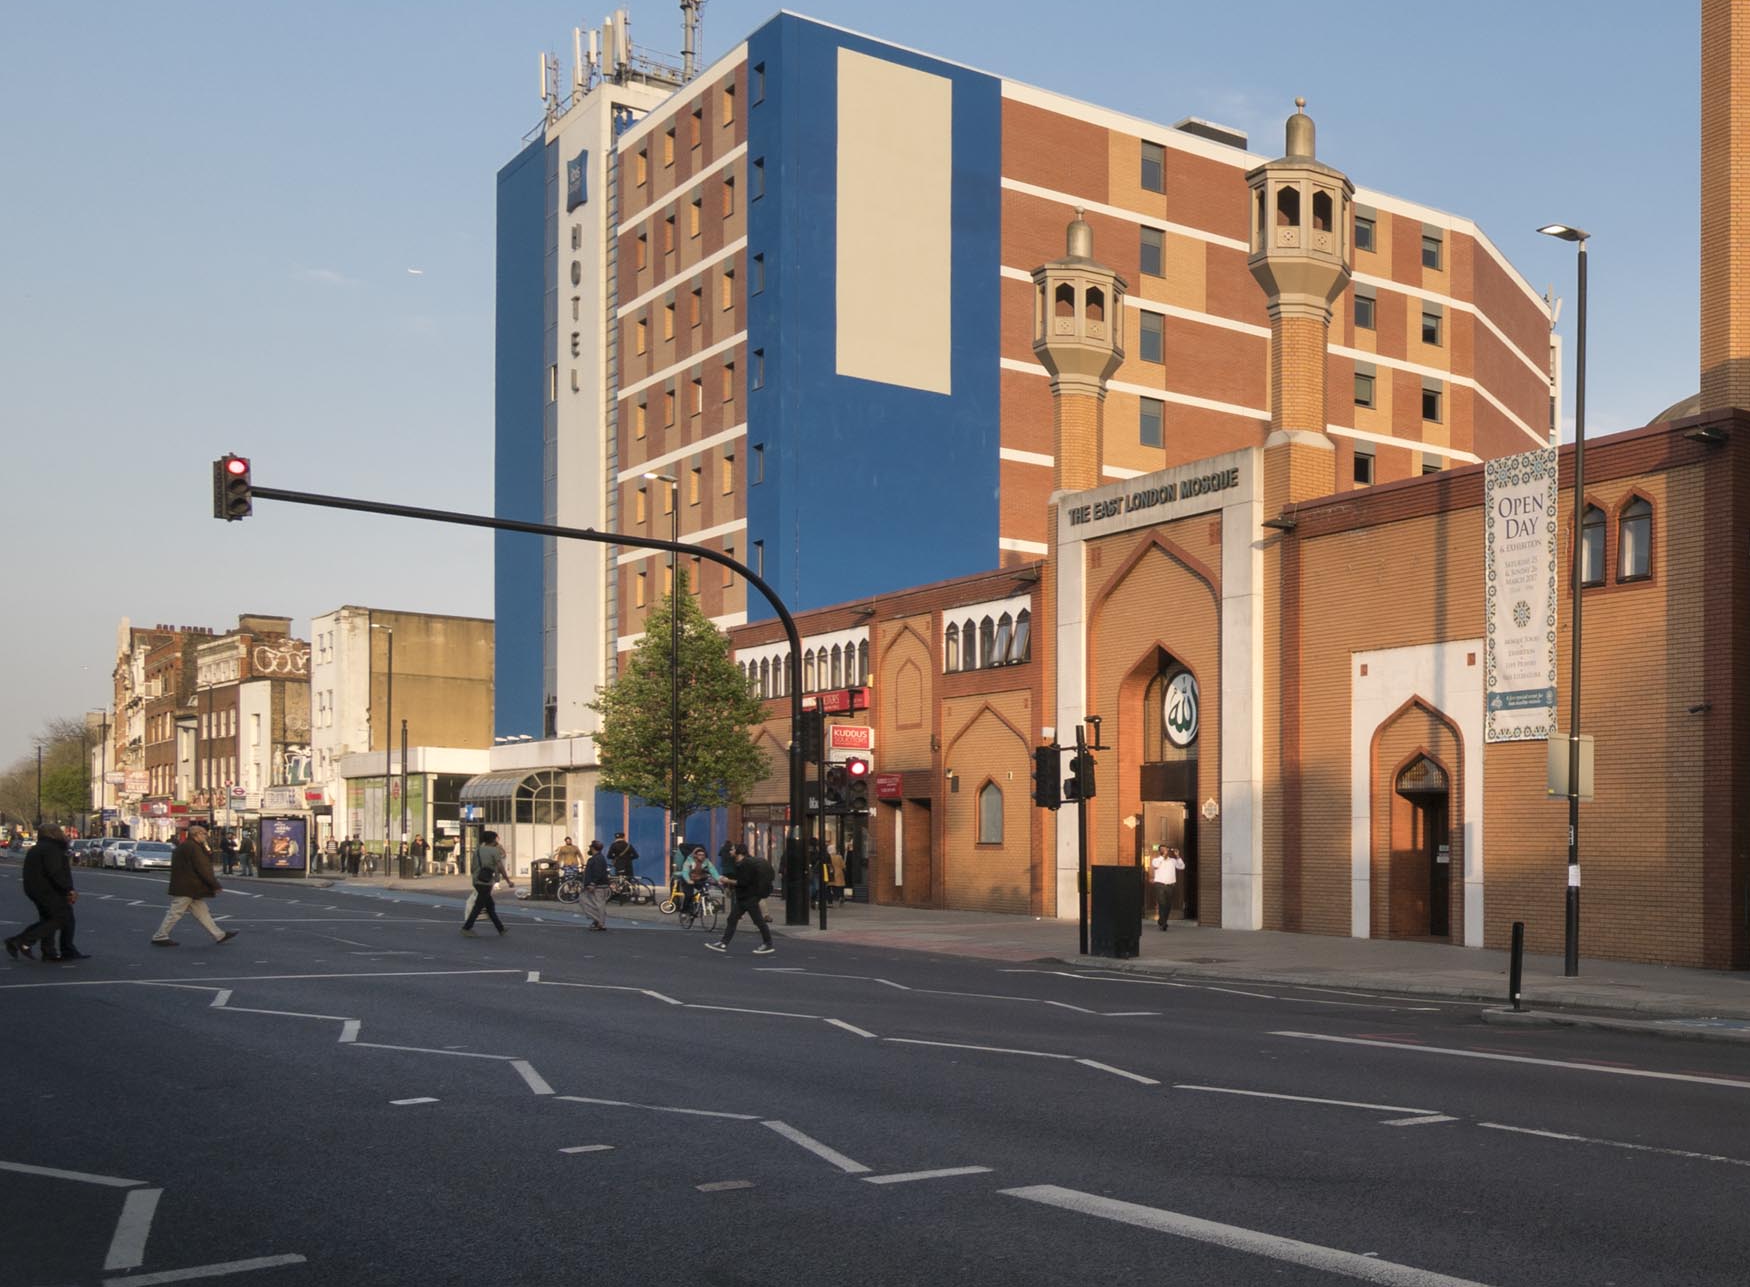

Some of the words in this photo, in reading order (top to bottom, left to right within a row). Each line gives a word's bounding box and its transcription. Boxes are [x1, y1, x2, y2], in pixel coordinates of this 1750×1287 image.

[570, 223, 582, 394] HOTEL
[1068, 504, 1091, 526] THE
[1093, 496, 1124, 520] EAST
[1125, 483, 1177, 513] LONDON
[1180, 467, 1239, 500] MOSQUE
[1498, 493, 1544, 518] OPEN
[1505, 516, 1539, 539] DAY
[834, 729, 867, 737] KUDDUS
